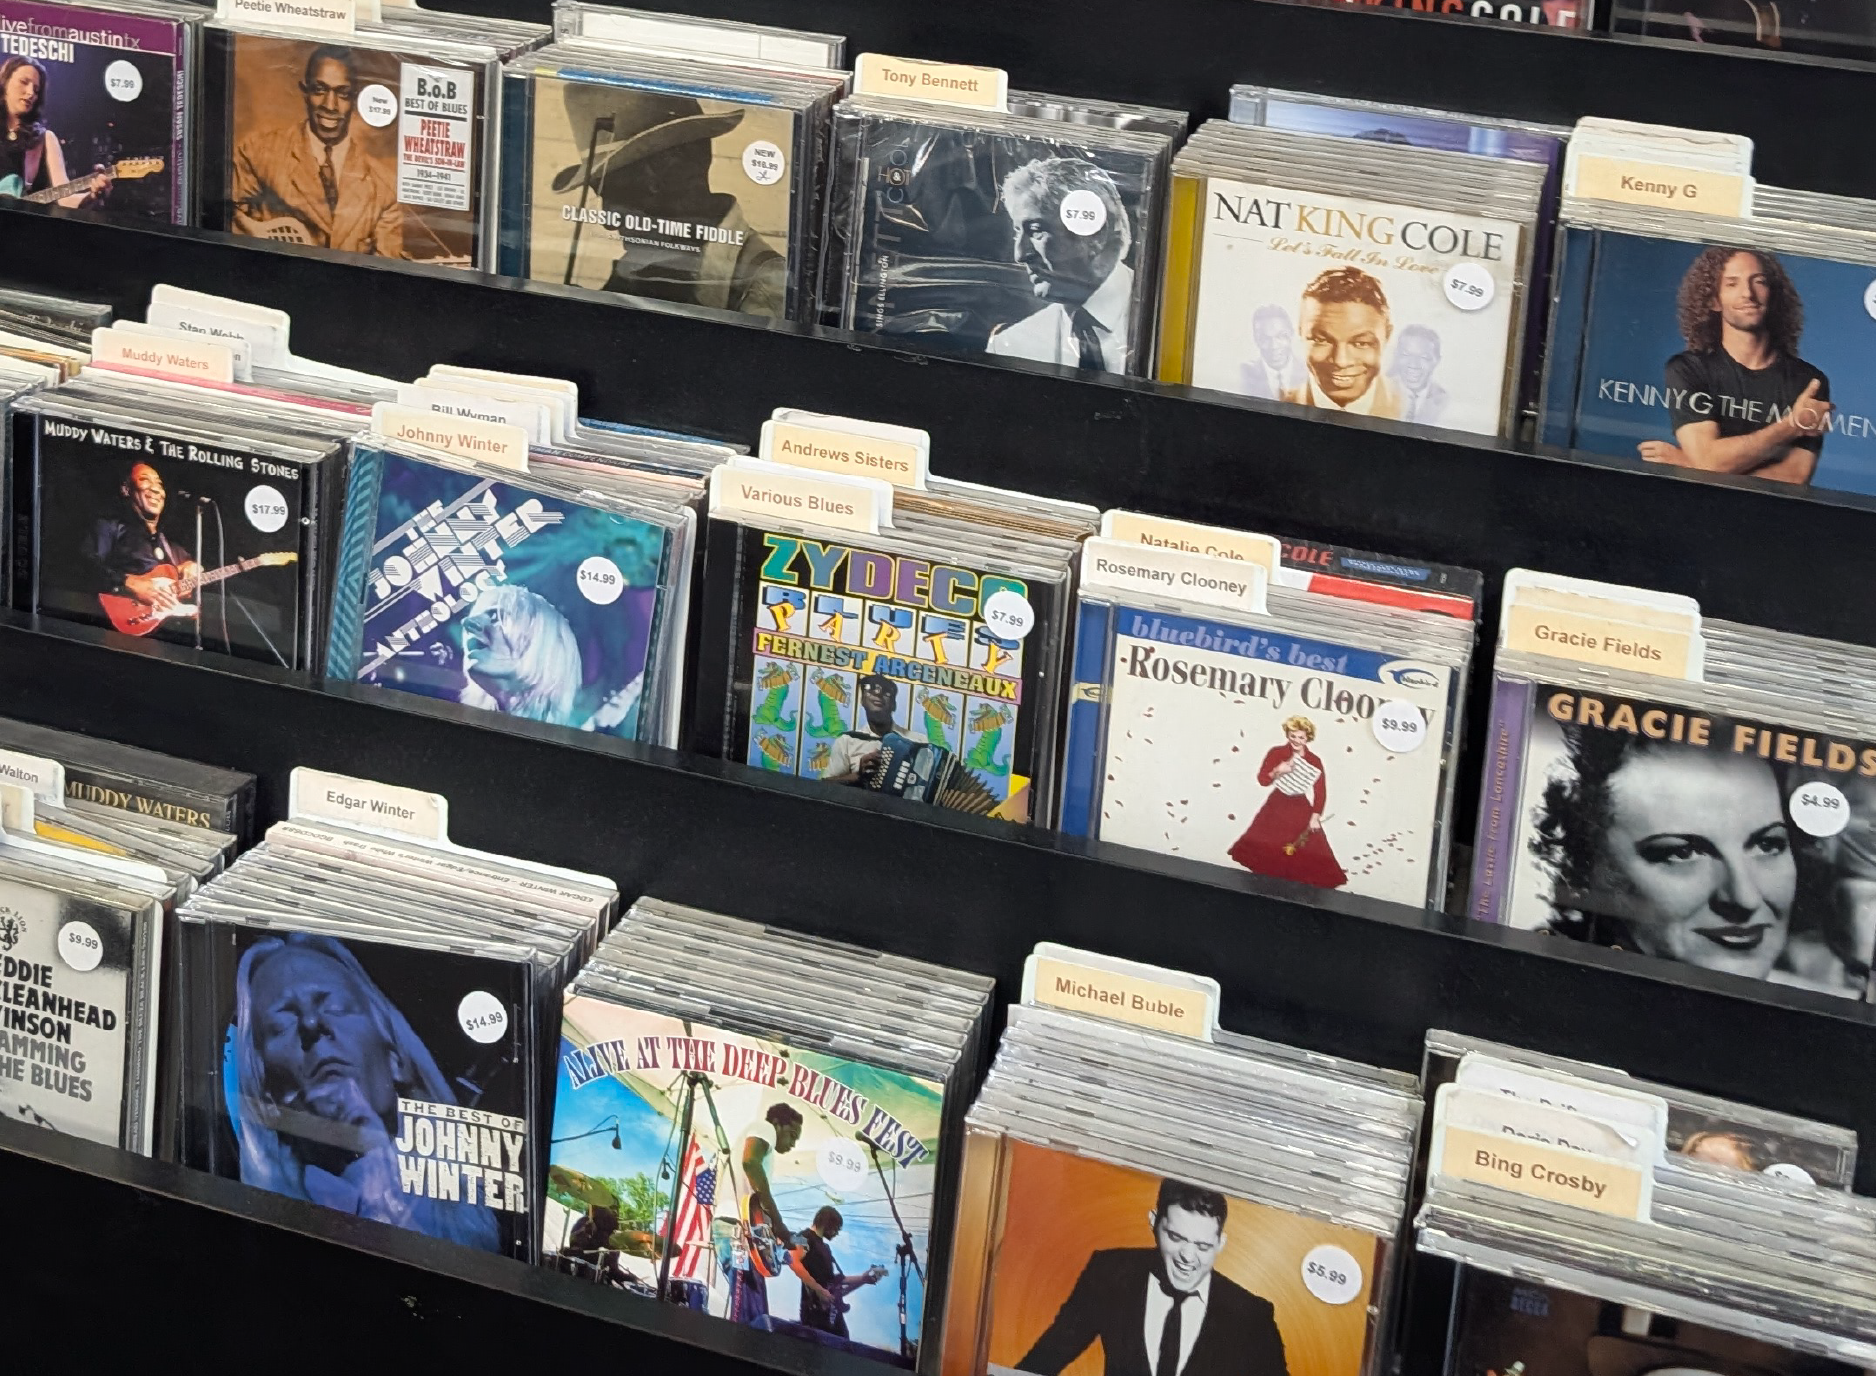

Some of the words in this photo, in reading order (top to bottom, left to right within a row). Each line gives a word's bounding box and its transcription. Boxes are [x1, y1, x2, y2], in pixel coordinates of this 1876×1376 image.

[236, 0, 271, 12] Peetie
[275, 2, 346, 19] Wheatstraw
[1, 34, 74, 63] TEDESCHI
[110, 78, 135, 89] $7.99
[417, 77, 457, 100] B.o.B
[882, 68, 917, 87] Tony
[921, 73, 979, 92] Bennett
[405, 98, 425, 110] BEST
[428, 101, 439, 111] OF
[442, 102, 467, 115] BLUES
[421, 119, 450, 138] PEETIE
[404, 135, 465, 159] WHEATSTRAW
[754, 148, 776, 158] NEW
[1620, 175, 1677, 199] Kenny
[1682, 184, 1697, 198] G
[562, 204, 622, 228] CLASSIC
[625, 213, 691, 239] OLD-TIME
[695, 224, 744, 246] FIDDLE
[1066, 209, 1096, 221] $7.99
[1213, 192, 1291, 230] NAT
[1296, 204, 1395, 245] KING
[1401, 221, 1504, 261] COLE
[660, 241, 701, 253] FOLKWAYS
[1267, 236, 1311, 256] Let's
[1316, 244, 1358, 263] Fall
[1361, 251, 1388, 267] In
[1392, 255, 1440, 275] Love
[1450, 278, 1484, 297] $7.99
[122, 347, 163, 365] Muddy
[166, 353, 209, 370] Waters
[1717, 394, 1764, 423] THE
[44, 419, 88, 441] MUDDY
[91, 428, 142, 451] WATERS
[160, 440, 184, 459] THE
[188, 445, 244, 470] ROLLING
[250, 457, 299, 480] STONES
[397, 424, 453, 448] Johnny
[457, 433, 508, 453] Winter
[781, 440, 850, 463] Andrews
[854, 451, 909, 472] Sisters
[252, 503, 286, 516] $17.99
[741, 484, 803, 508] Various
[808, 495, 854, 515] Blues
[404, 498, 445, 542] THE
[367, 488, 501, 600] JOHNNY
[408, 498, 566, 603] WINTER
[579, 569, 616, 587] $14.99
[1097, 558, 1175, 586] Rosemary
[1180, 571, 1248, 598] Clooney
[376, 558, 508, 659] ANTHOLOGY
[991, 609, 1024, 628] $7.99
[757, 633, 867, 670] FERNEST
[769, 602, 1014, 675] PARTY
[1132, 615, 1280, 660] bluebird's
[1288, 643, 1348, 674] best
[1534, 624, 1598, 649] Gracie
[1602, 637, 1662, 661] Fields
[1127, 644, 1293, 710] Rosemary
[1300, 676, 1436, 726] Clooy
[1381, 717, 1418, 734] $9.99
[1547, 692, 1711, 747] GRACIE
[1731, 724, 1876, 778] FIELDS
[65, 781, 133, 809] MUDDY
[135, 796, 211, 829] WATERS
[326, 790, 367, 810] Edgar
[370, 799, 416, 820] Winter
[1801, 793, 1840, 810] $4.99
[69, 932, 99, 950] $9.99
[0, 953, 53, 989] DDIE
[0, 981, 117, 1031] LEANHEAD
[1055, 976, 1126, 1006] Michael
[1131, 994, 1186, 1018] Buble
[0, 1005, 72, 1045] INSON
[466, 1011, 504, 1031] $14.99
[31, 1062, 93, 1103] BLUES
[402, 1100, 437, 1116] THE
[445, 1107, 493, 1125] BEST
[501, 1117, 524, 1131] OF
[564, 1039, 630, 1091] ALIVE
[636, 1036, 662, 1070] AT
[667, 1036, 716, 1073] THE
[722, 1043, 787, 1090] DEEP
[788, 1062, 868, 1126] BLUES
[861, 1104, 930, 1170] FEST
[395, 1115, 524, 1173] JOHNNY
[397, 1153, 525, 1215] WINTER
[1475, 1150, 1523, 1179] Bing
[1531, 1164, 1608, 1199] Crosby
[1307, 1261, 1347, 1287] $5.99
